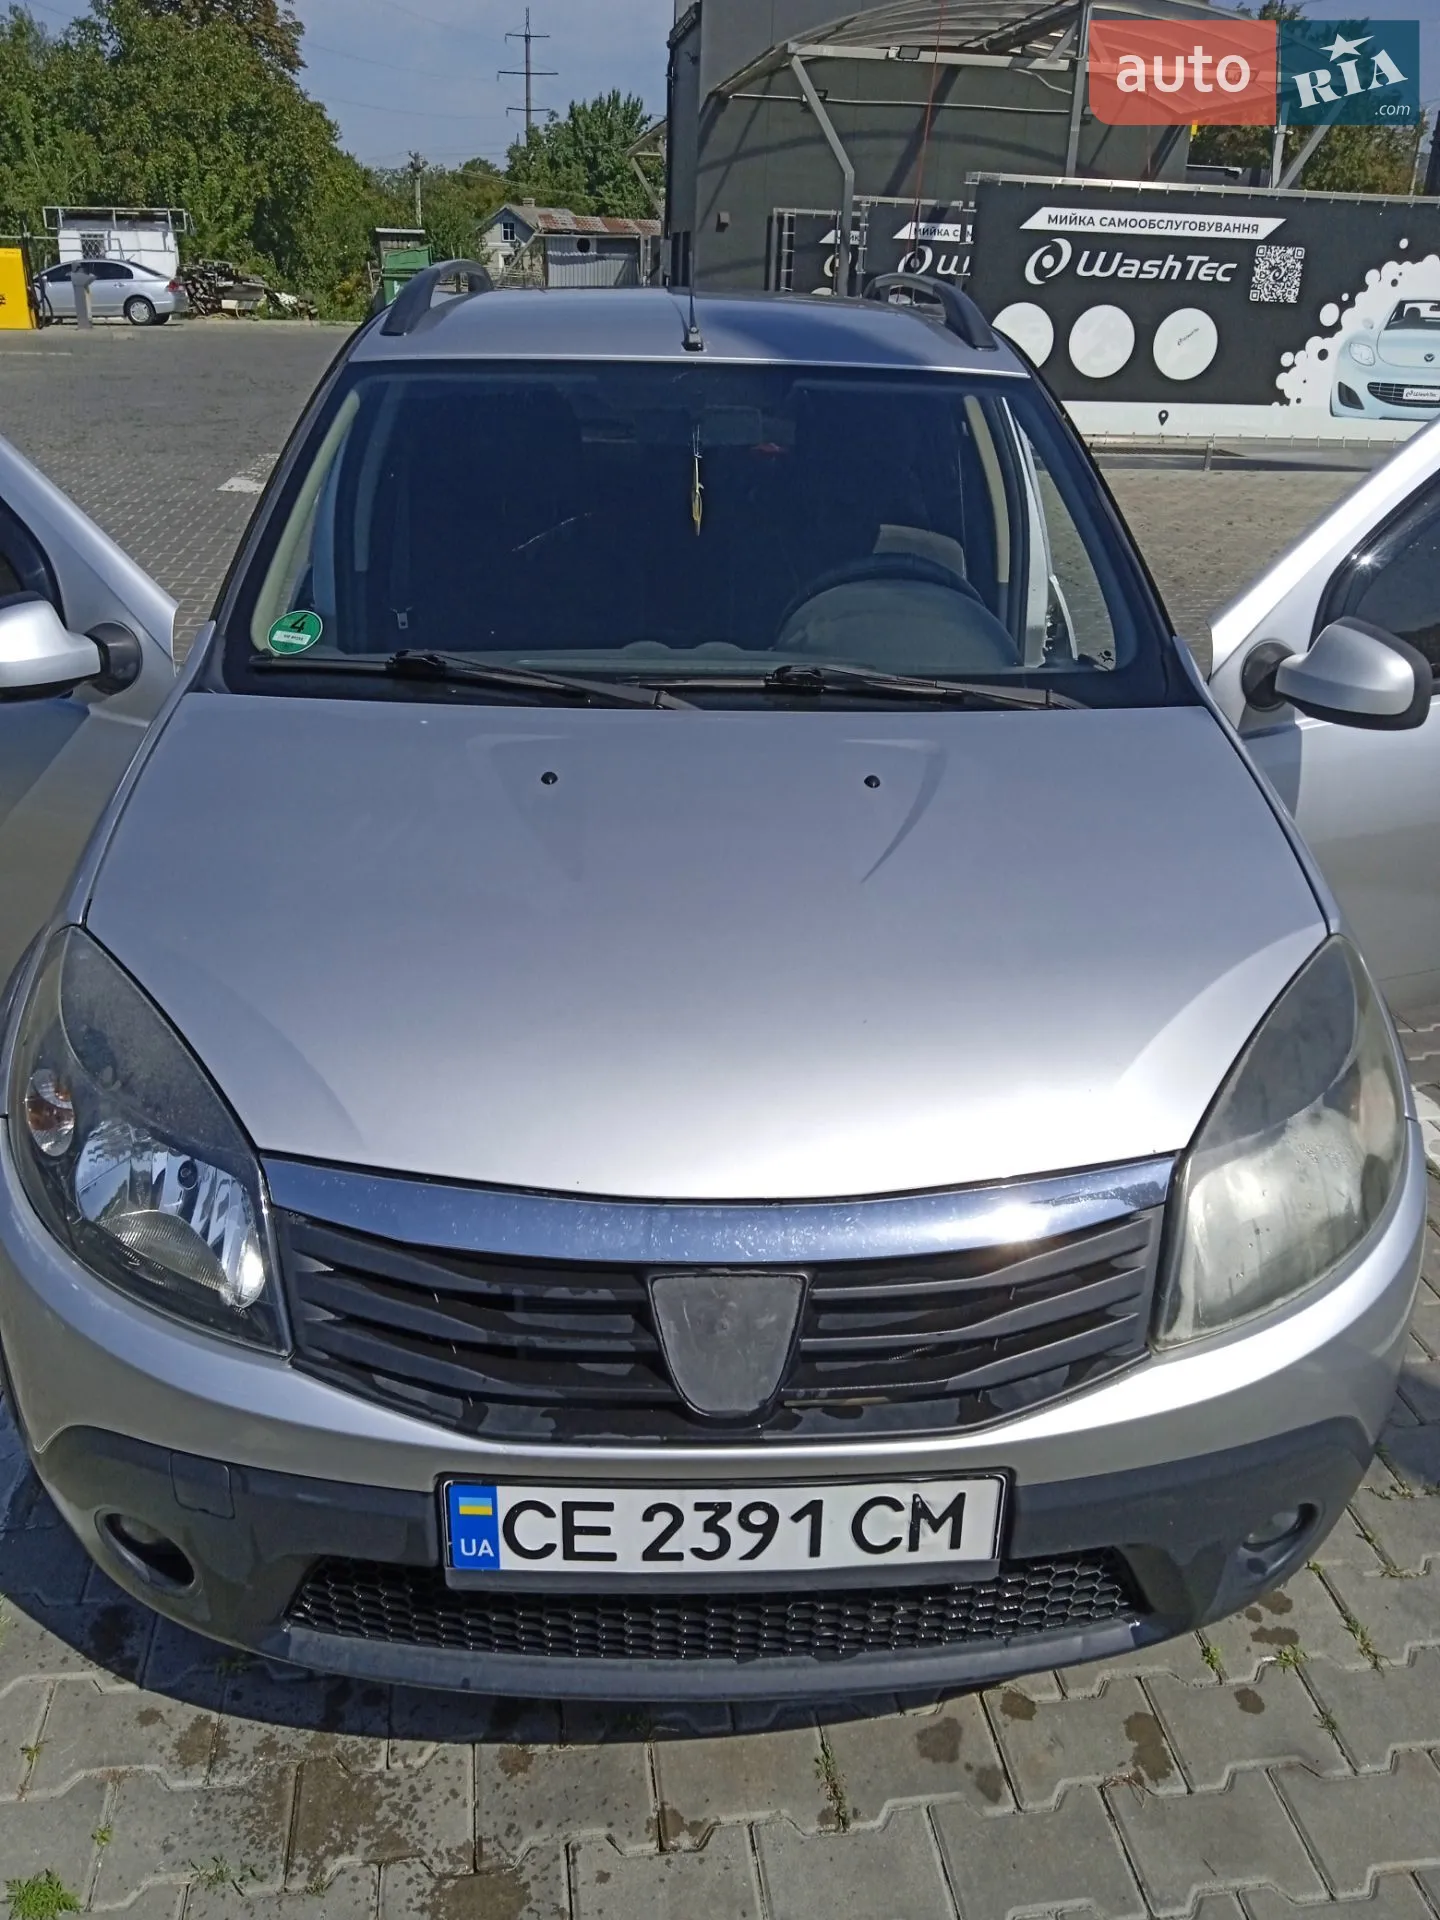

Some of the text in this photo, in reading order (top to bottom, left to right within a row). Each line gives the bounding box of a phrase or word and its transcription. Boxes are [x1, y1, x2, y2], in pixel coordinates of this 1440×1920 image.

[1047, 213, 1259, 234] МИЙКА САМООБСЛУГОВУВАННЯ
[1076, 250, 1238, 283] WashTec
[290, 614, 309, 632] 4
[501, 1492, 966, 1562] CE 2391 CM
[460, 1539, 495, 1559] UA
